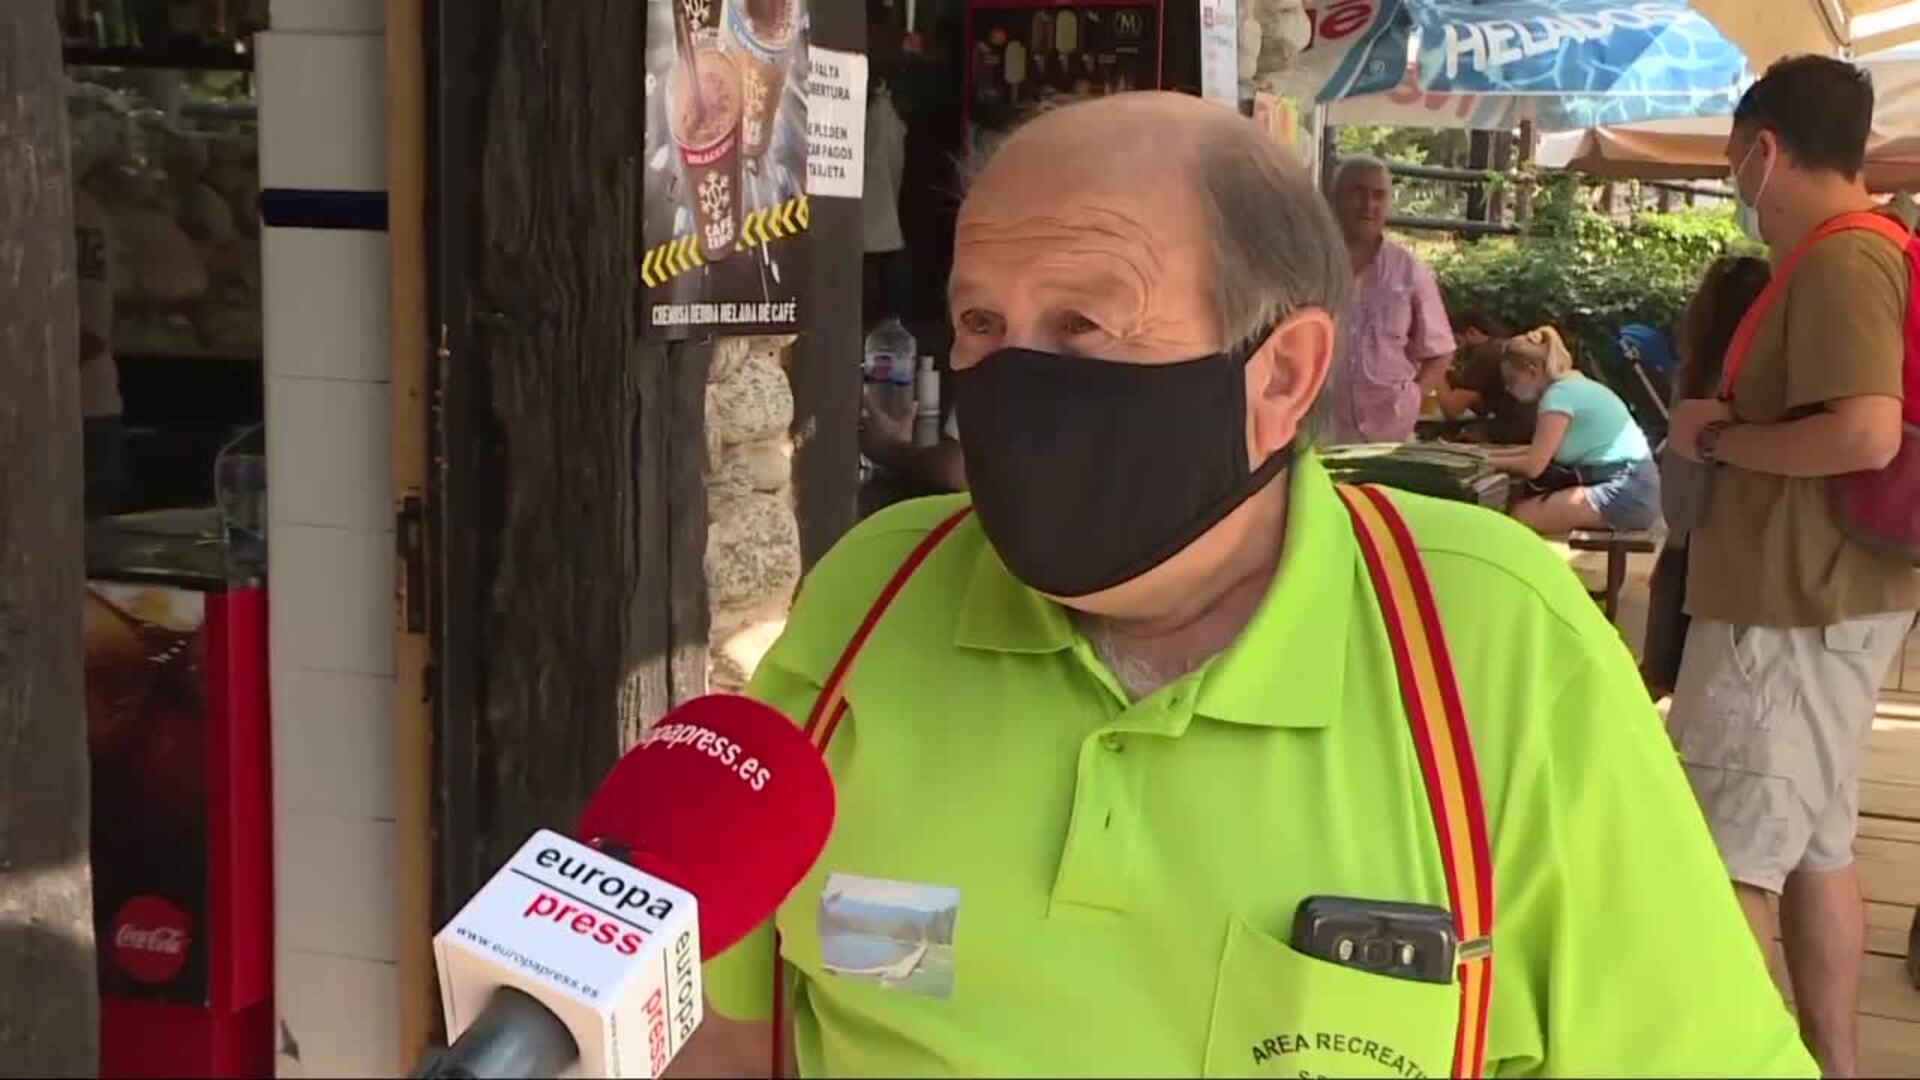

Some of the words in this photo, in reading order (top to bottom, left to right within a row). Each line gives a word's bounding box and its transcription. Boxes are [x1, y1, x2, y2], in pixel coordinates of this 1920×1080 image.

[1443, 4, 1690, 79] HELADOS
[807, 82, 850, 101] OBERTURA
[822, 145, 852, 160] PAGOS
[771, 297, 796, 322] CAFÉ
[642, 723, 771, 791] papress.es
[536, 848, 674, 921] europa
[523, 892, 643, 956] press
[456, 926, 600, 999] www.europapress.es
[675, 931, 695, 1041] europa
[641, 987, 667, 1078] press
[1251, 1033, 1311, 1066] AREA
